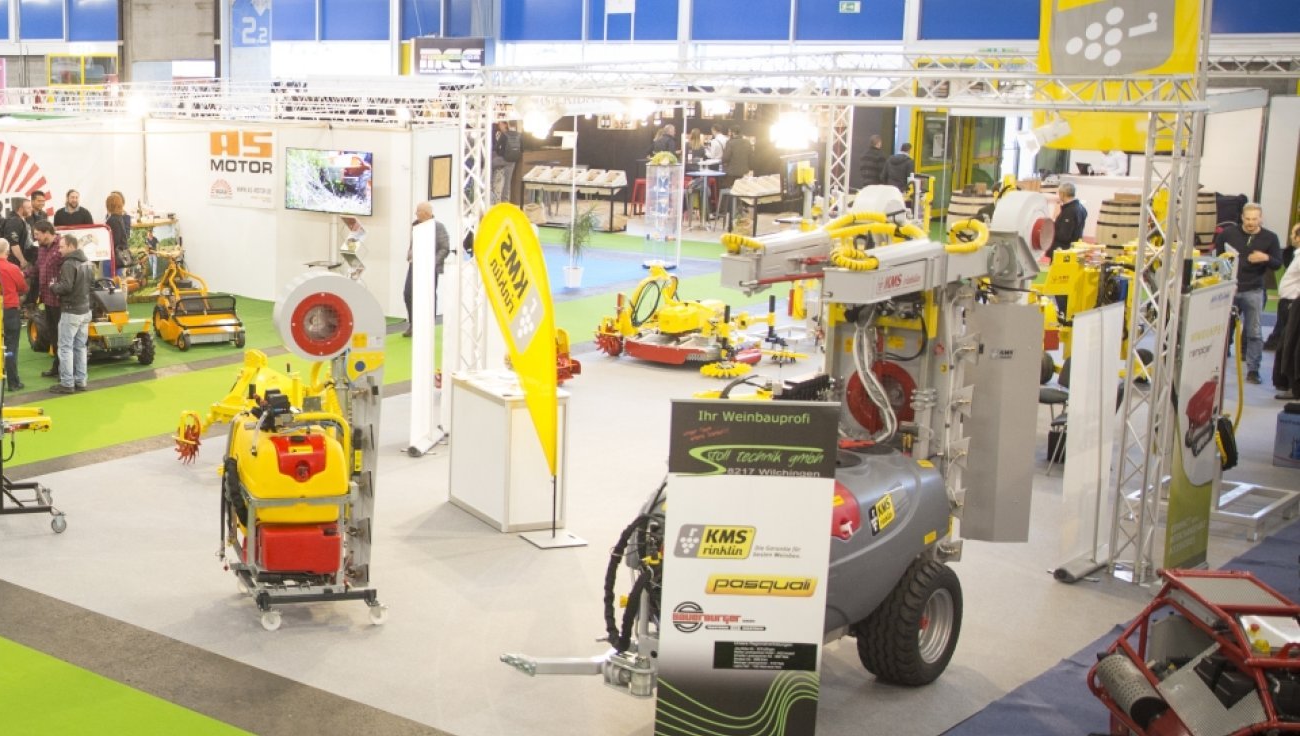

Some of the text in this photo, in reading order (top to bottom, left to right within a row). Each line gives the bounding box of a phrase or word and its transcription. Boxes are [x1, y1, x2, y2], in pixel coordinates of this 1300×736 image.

[210, 131, 273, 158] AS
[210, 159, 273, 174] MOTOR
[698, 410, 811, 425] Ihr Weinbauprofi
[736, 450, 781, 464] technik
[787, 451, 824, 468] gmbh
[727, 467, 821, 478] 8217 Wilchingen
[705, 528, 748, 544] KMS
[702, 545, 743, 556] rinklin
[713, 578, 811, 592] pasquali
